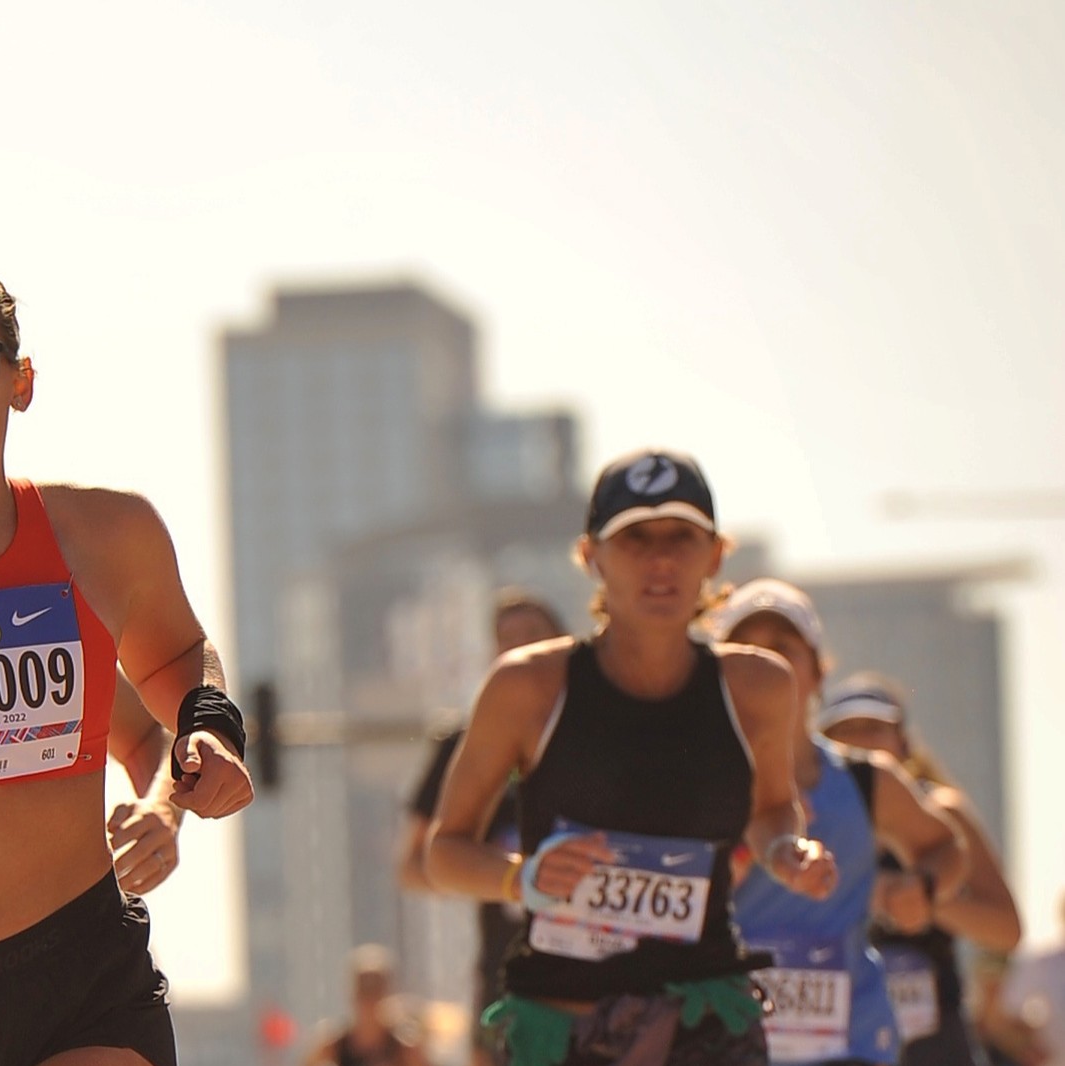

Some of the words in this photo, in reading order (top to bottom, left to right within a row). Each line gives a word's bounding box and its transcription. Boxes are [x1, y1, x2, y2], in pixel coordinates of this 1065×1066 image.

[3, 713, 27, 724] 2022
[41, 747, 55, 761] 601
[590, 872, 692, 922] 33763
